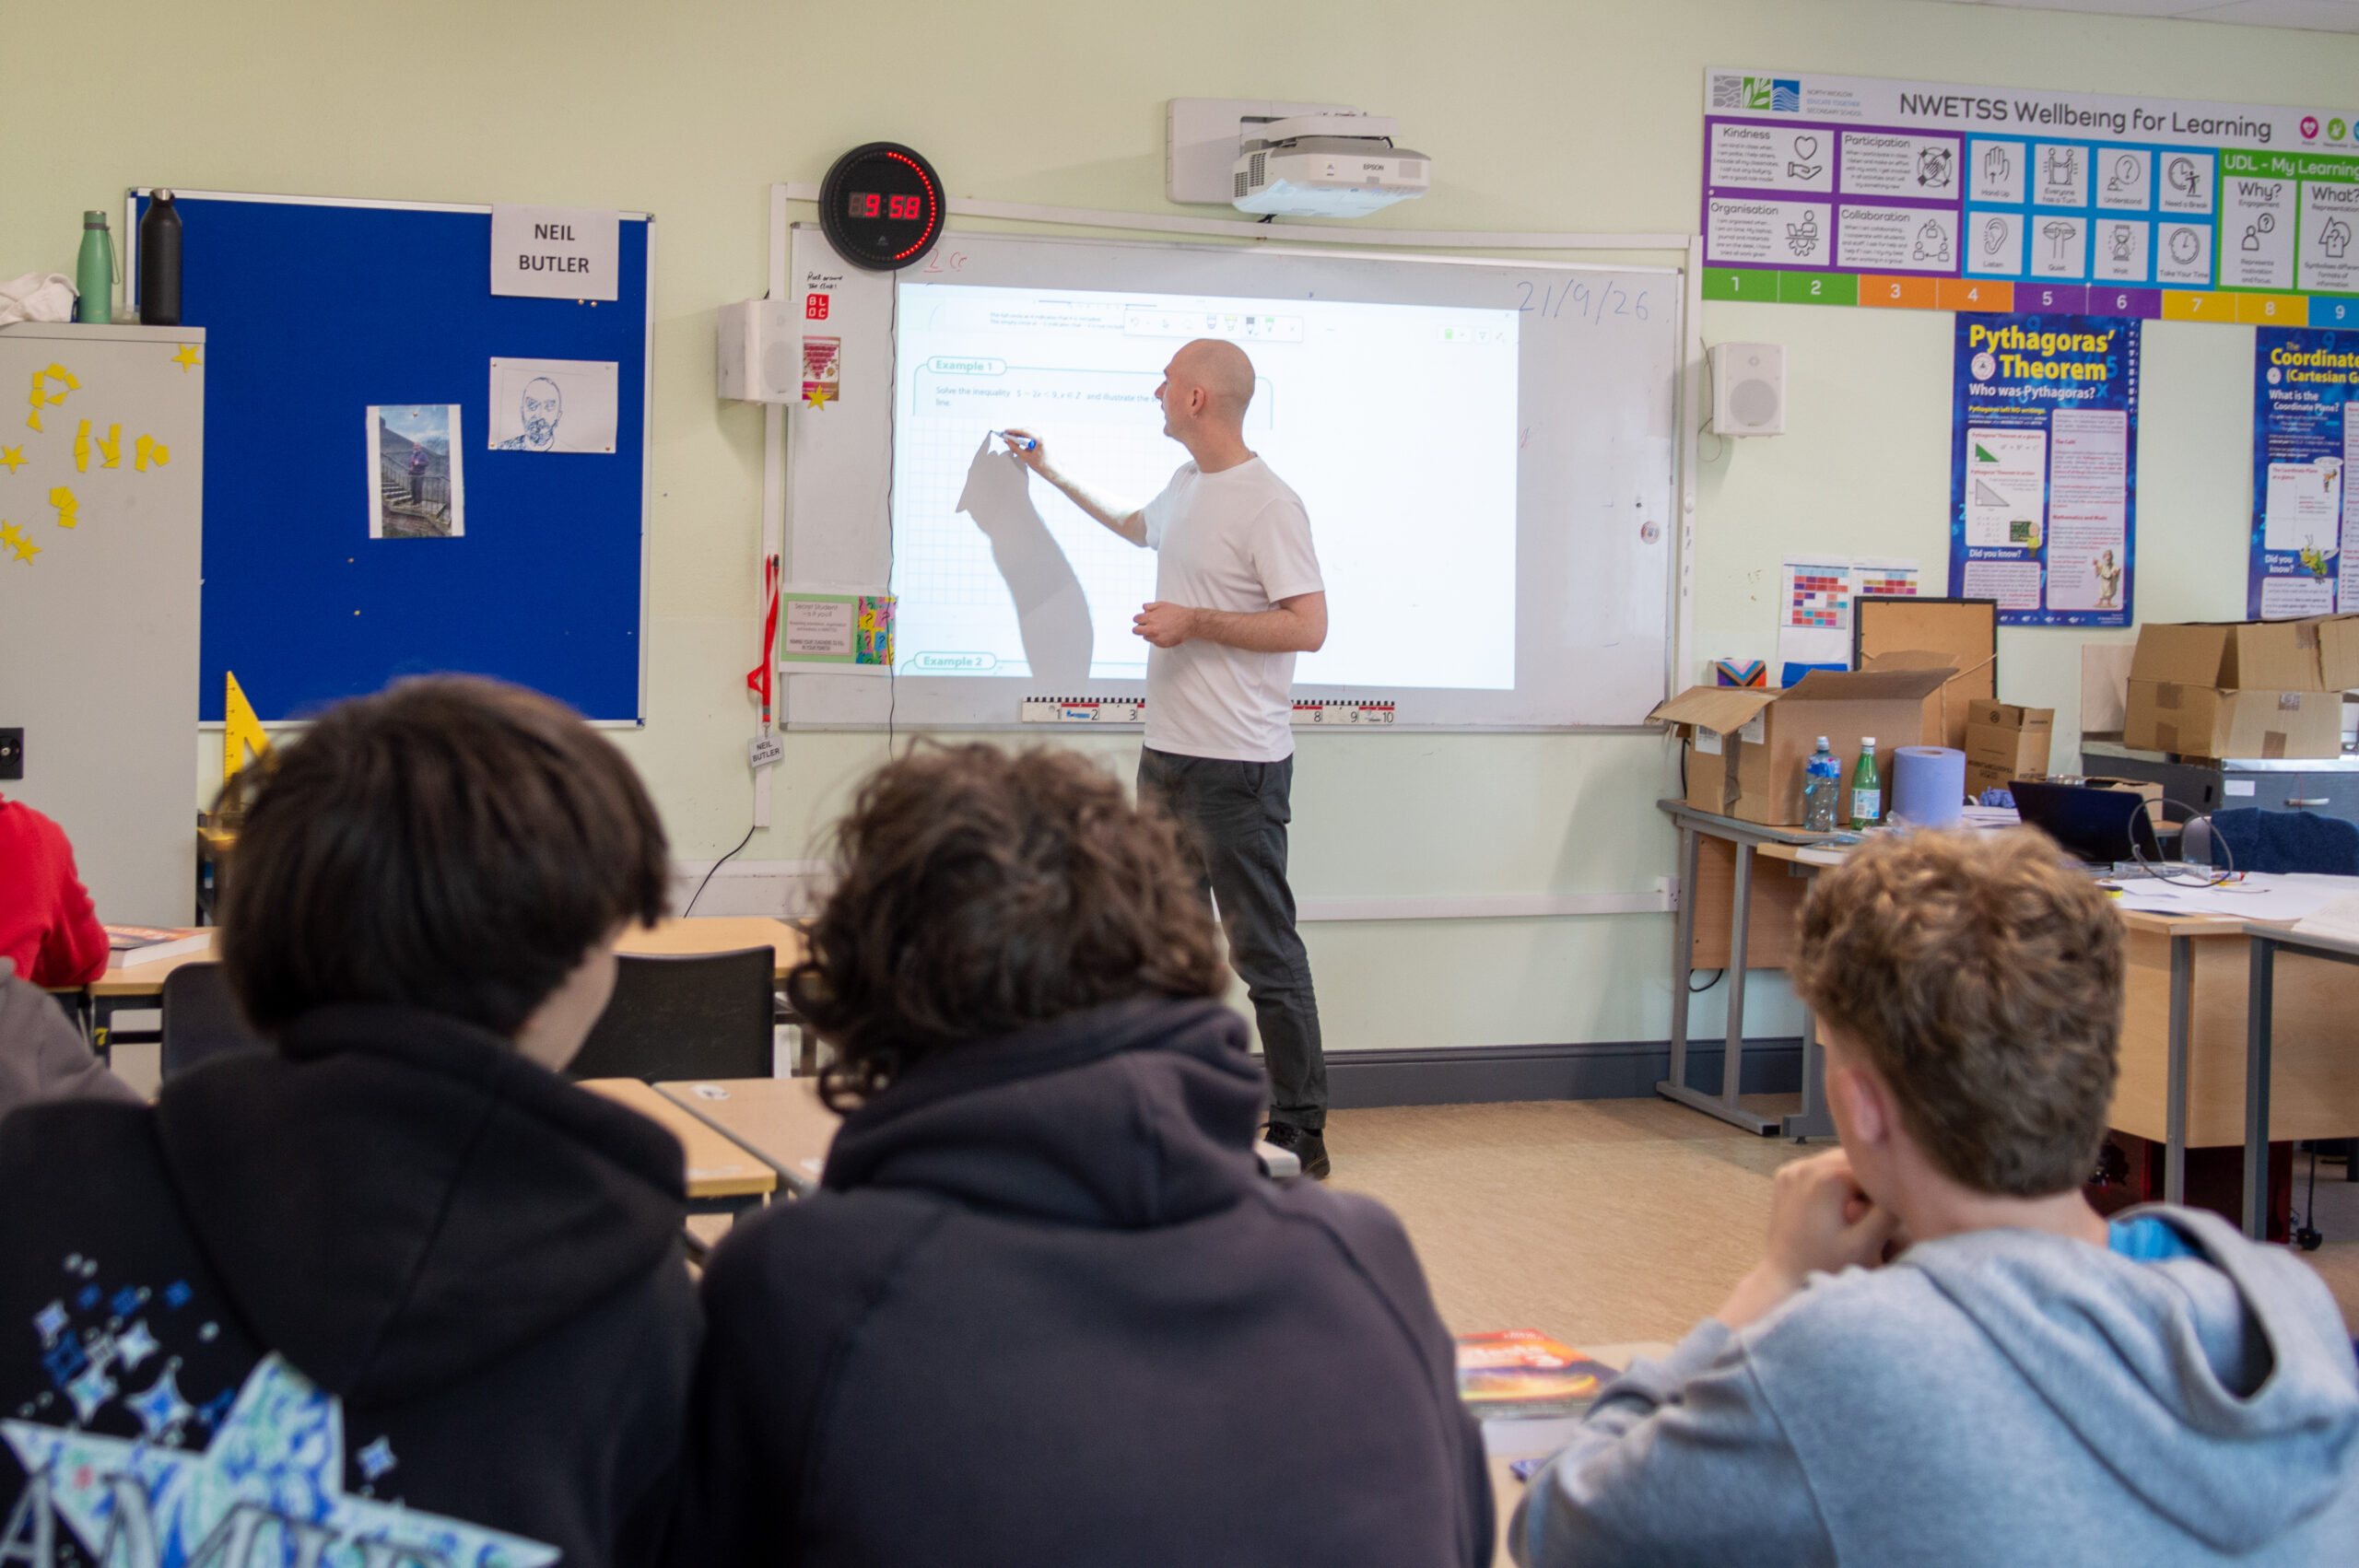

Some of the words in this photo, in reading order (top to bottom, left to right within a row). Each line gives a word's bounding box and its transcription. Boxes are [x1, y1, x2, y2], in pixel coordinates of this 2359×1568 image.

[1900, 93, 2007, 121] NWETSS
[2014, 101, 2126, 134] Wellbeing
[2133, 109, 2166, 131] for
[2172, 112, 2272, 143] Learning
[1723, 128, 1771, 140] Kindness
[1844, 135, 1911, 149] Participation
[2224, 154, 2257, 170] UDL
[2271, 157, 2295, 176] My
[2045, 188, 2075, 196] Everyone
[2238, 181, 2282, 201] Why?
[2104, 197, 2142, 205] Understand
[1711, 202, 1779, 216] Organisation
[1842, 209, 1910, 222] Collaboration
[534, 224, 575, 241] NEIL
[519, 255, 590, 274] BUTLER
[1731, 276, 1739, 292] 1
[1810, 280, 1822, 295] 2
[1890, 283, 1901, 298] 3
[1967, 287, 1978, 302] 4
[2042, 291, 2053, 306] 5
[2116, 294, 2127, 310] 6
[2191, 298, 2202, 313] 7
[2265, 301, 2276, 316] 8
[2335, 305, 2346, 320] 9
[2286, 342, 2300, 351] The
[936, 360, 984, 372] Example
[988, 362, 992, 371] 1
[2000, 354, 2107, 380] Theorem
[2286, 369, 2347, 384] (Cartesian
[936, 386, 957, 395] Solve
[958, 387, 971, 396] the
[973, 388, 1010, 398] inequality
[1103, 393, 1135, 402] illustrate
[1969, 383, 1995, 396] Who
[1998, 386, 2021, 397] was
[2025, 385, 2096, 400] Pythagoras?
[2269, 389, 2293, 400] What
[2294, 390, 2302, 400] is
[2303, 390, 2319, 401] the
[2274, 402, 2313, 411] Coordinate
[1969, 549, 1983, 558] Did
[1983, 550, 1998, 560] you
[1998, 549, 2022, 558] know?
[2265, 555, 2278, 563] Did
[2279, 556, 2294, 565] you
[2269, 565, 2294, 573] know?
[923, 656, 972, 667] Example
[975, 657, 983, 667] 2
[1055, 709, 1061, 720] 1
[1091, 709, 1099, 721] 2
[1129, 710, 1136, 721] 3
[1314, 711, 1321, 722] 8
[1350, 711, 1358, 723] 9
[1383, 712, 1394, 723] 10
[756, 740, 773, 752] NEIL
[752, 748, 780, 763] BUTLER
[94, 1027, 109, 1046] 7
